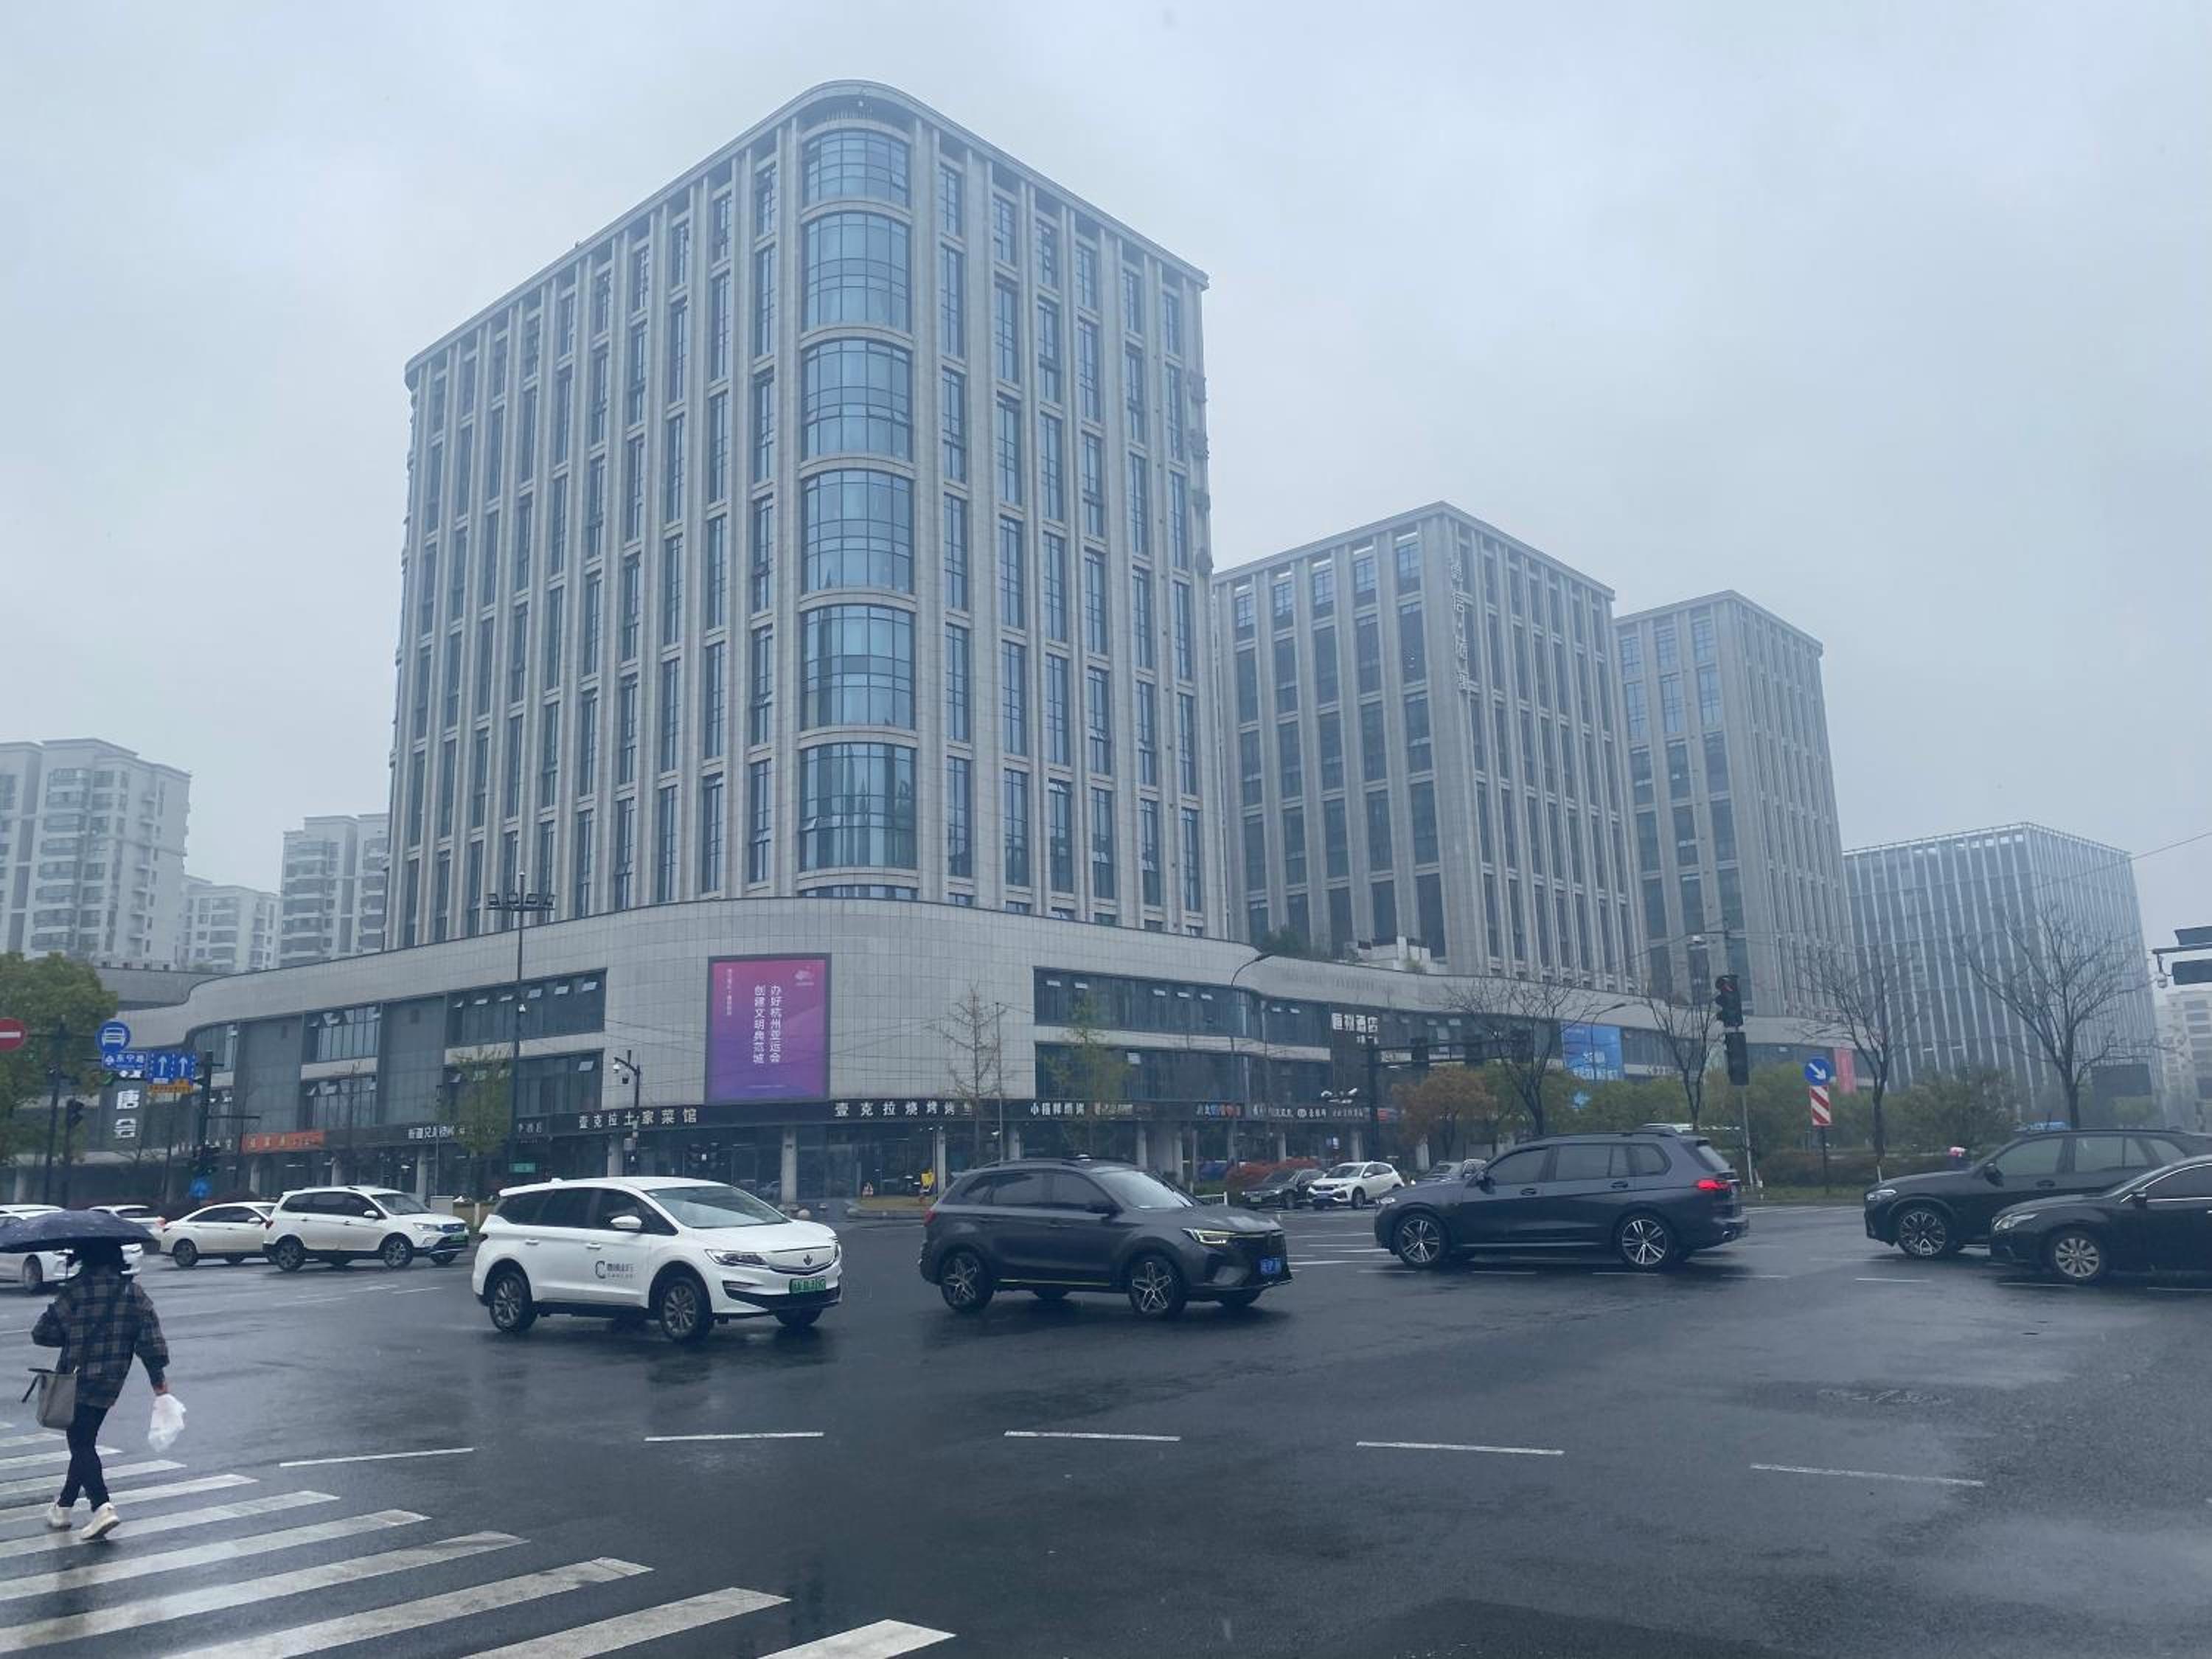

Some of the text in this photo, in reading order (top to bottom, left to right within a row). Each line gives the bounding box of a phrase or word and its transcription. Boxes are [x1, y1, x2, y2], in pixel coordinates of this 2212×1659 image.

[769, 984, 782, 1062] 办好杭州亚运会
[578, 1107, 697, 1129] 壹克拉土家菜馆
